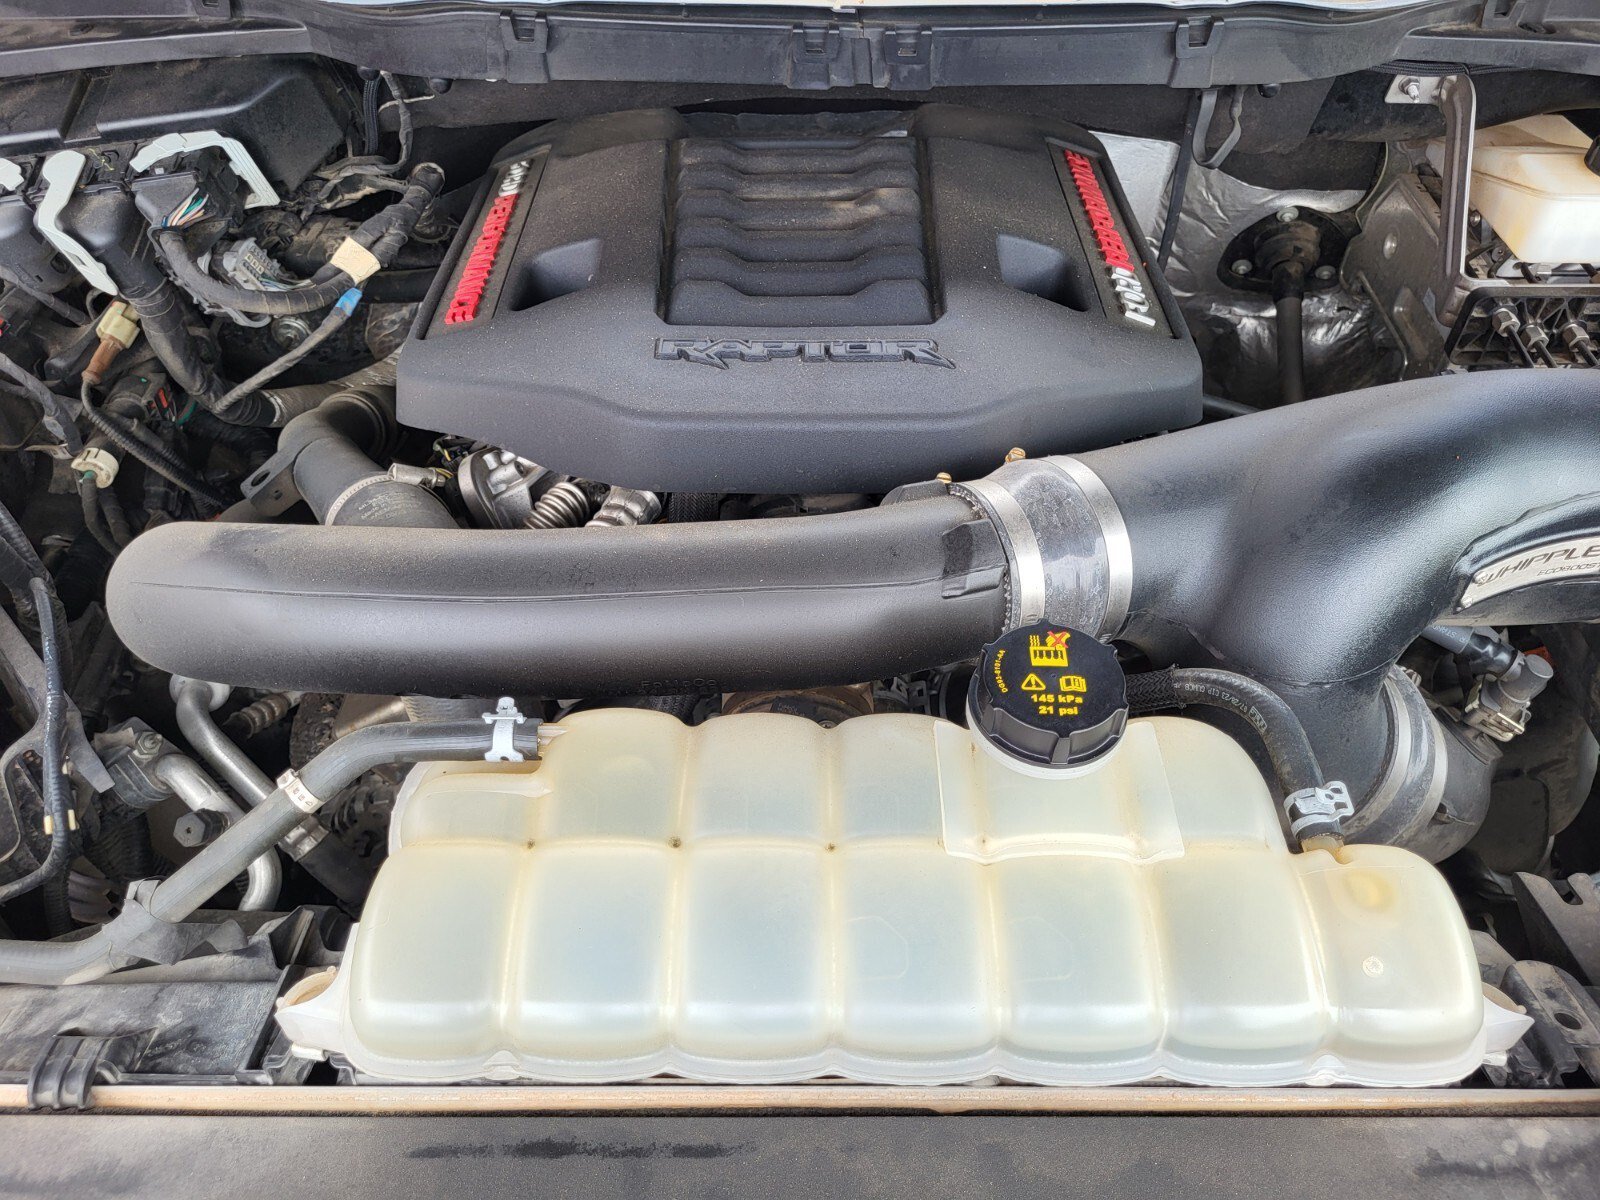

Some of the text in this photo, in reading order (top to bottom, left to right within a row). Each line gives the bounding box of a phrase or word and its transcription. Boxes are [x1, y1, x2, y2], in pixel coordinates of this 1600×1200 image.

[1064, 149, 1156, 327] FORD PERFORMANCE
[444, 194, 519, 325] PERFORMANCE
[654, 338, 956, 370] RAPTOR
[1031, 694, 1084, 704] 145 kPa
[1038, 705, 1079, 716] 21 psi
